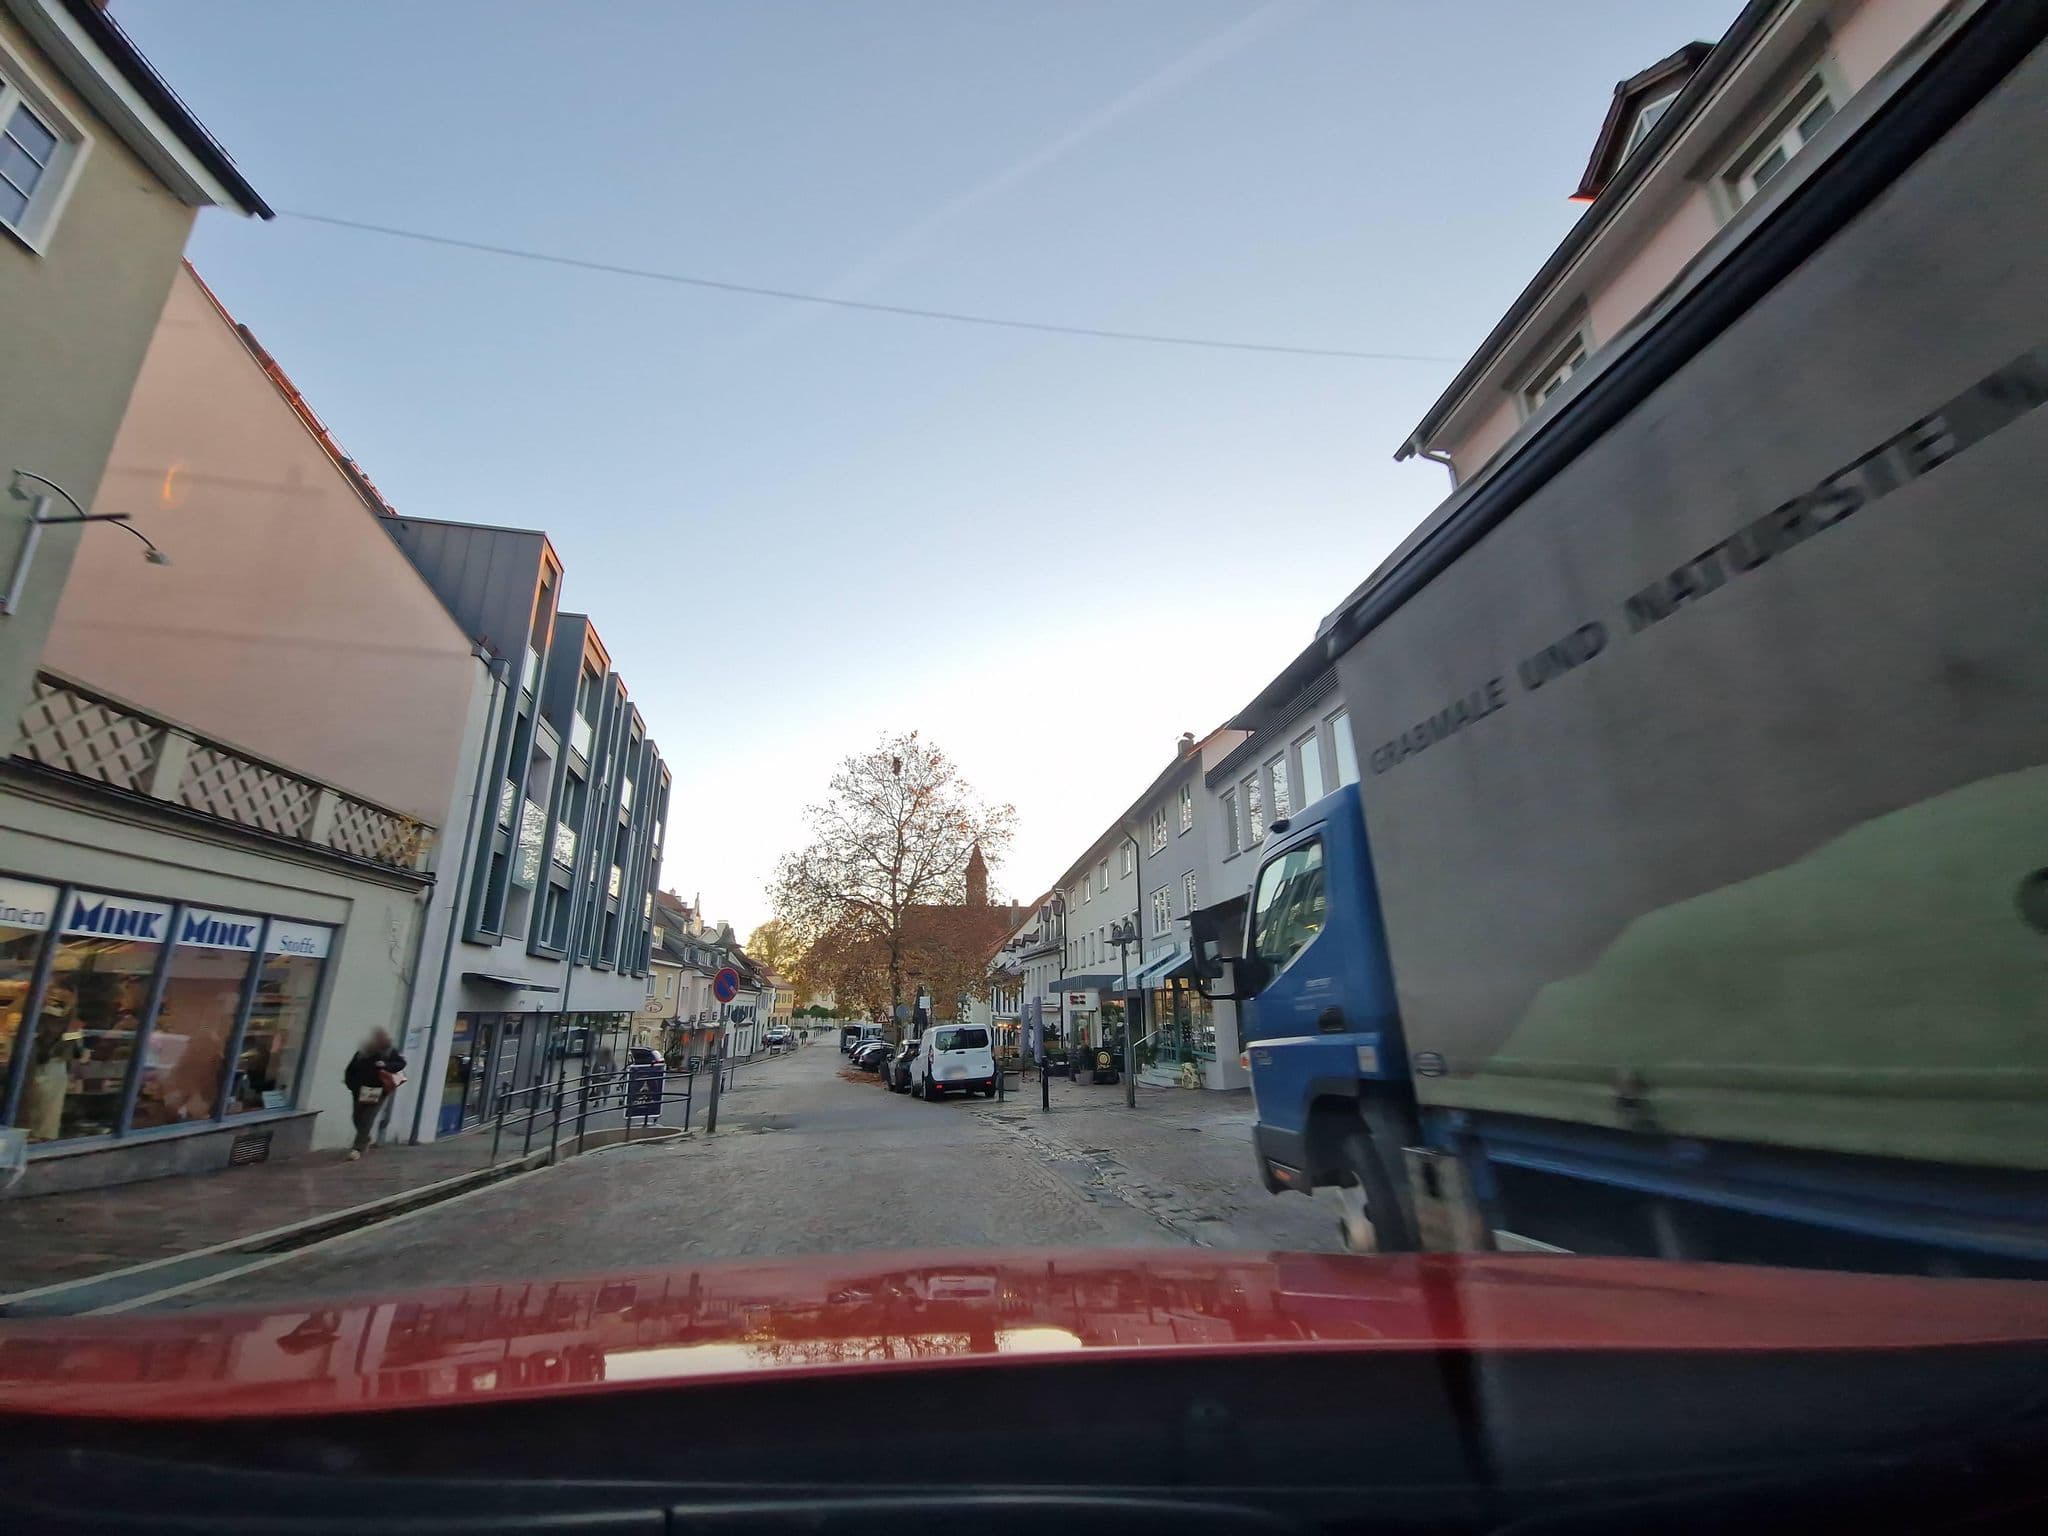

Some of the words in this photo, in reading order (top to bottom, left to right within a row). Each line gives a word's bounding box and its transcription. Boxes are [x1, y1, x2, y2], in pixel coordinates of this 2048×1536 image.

[1371, 675, 1507, 775] GRABMALE
[1517, 620, 1608, 692] UND
[69, 895, 163, 938] MINK
[181, 911, 256, 948] MINK
[279, 935, 315, 954] Stoffe
